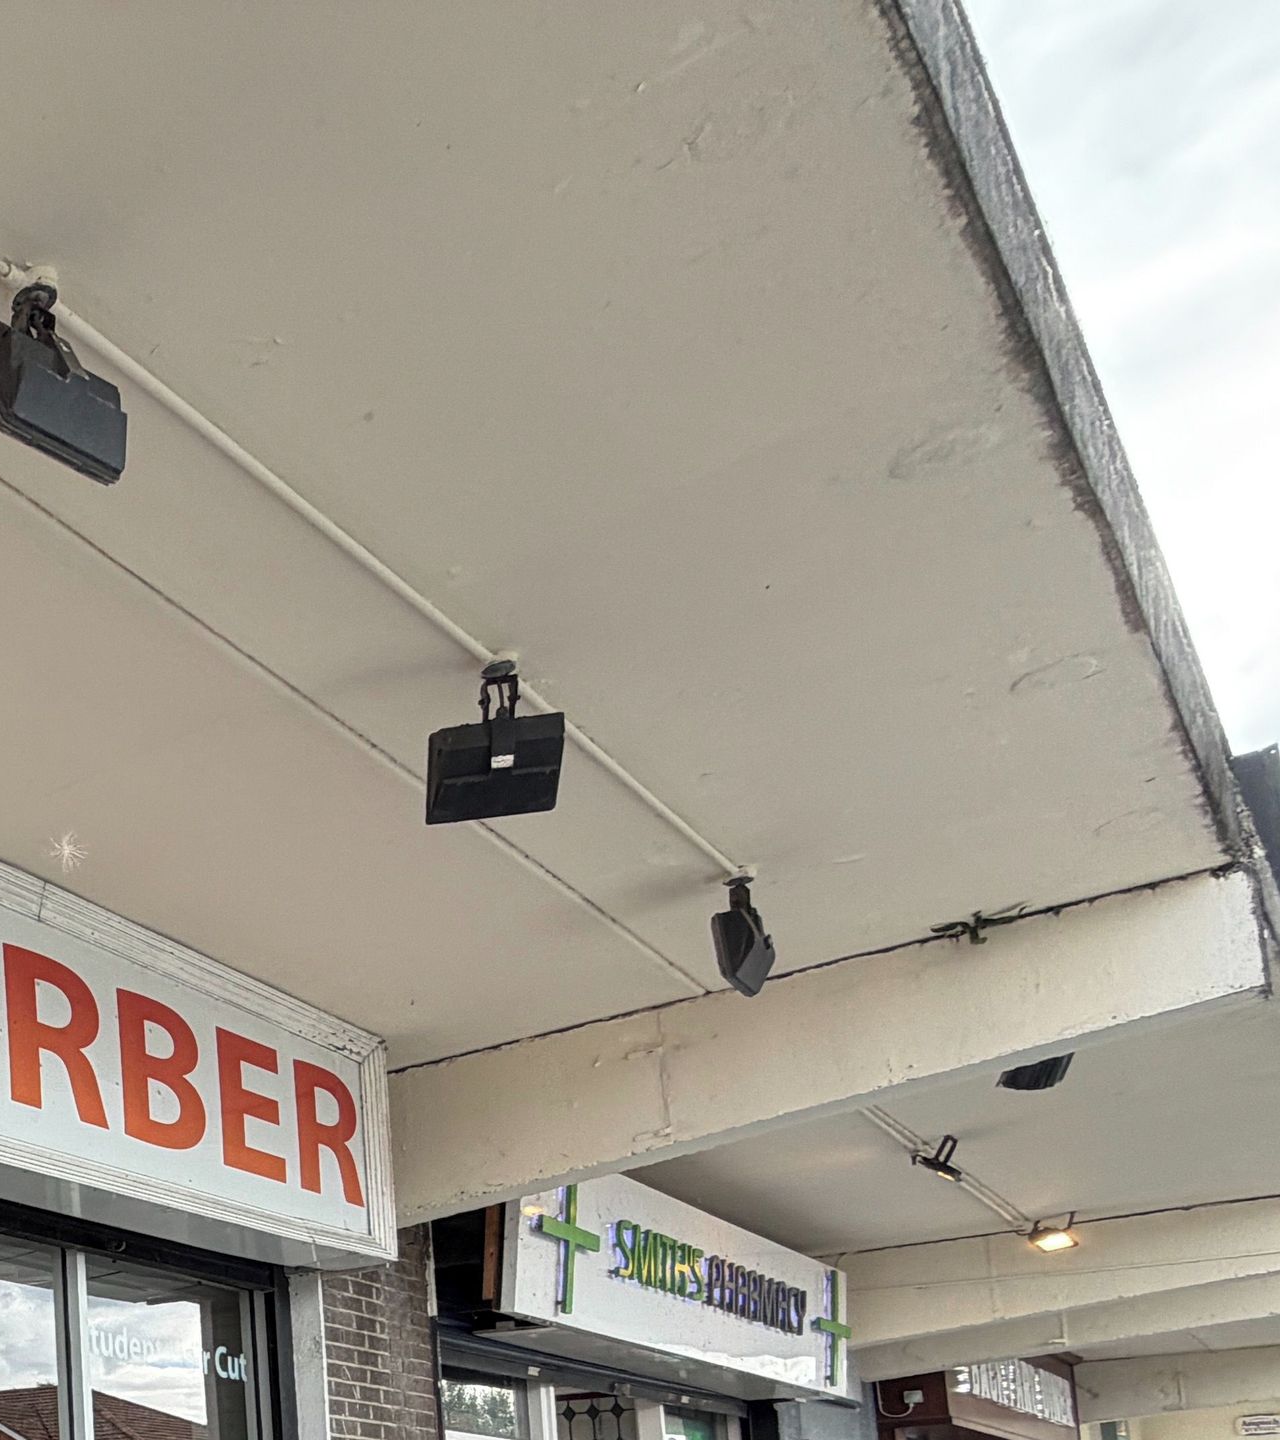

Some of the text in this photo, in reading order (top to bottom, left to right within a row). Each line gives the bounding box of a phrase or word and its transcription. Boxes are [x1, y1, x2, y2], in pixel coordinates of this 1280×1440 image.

[705, 1254, 807, 1336] PHARMACY
[89, 1327, 162, 1363] tuden
[214, 1346, 248, 1382] Cut
